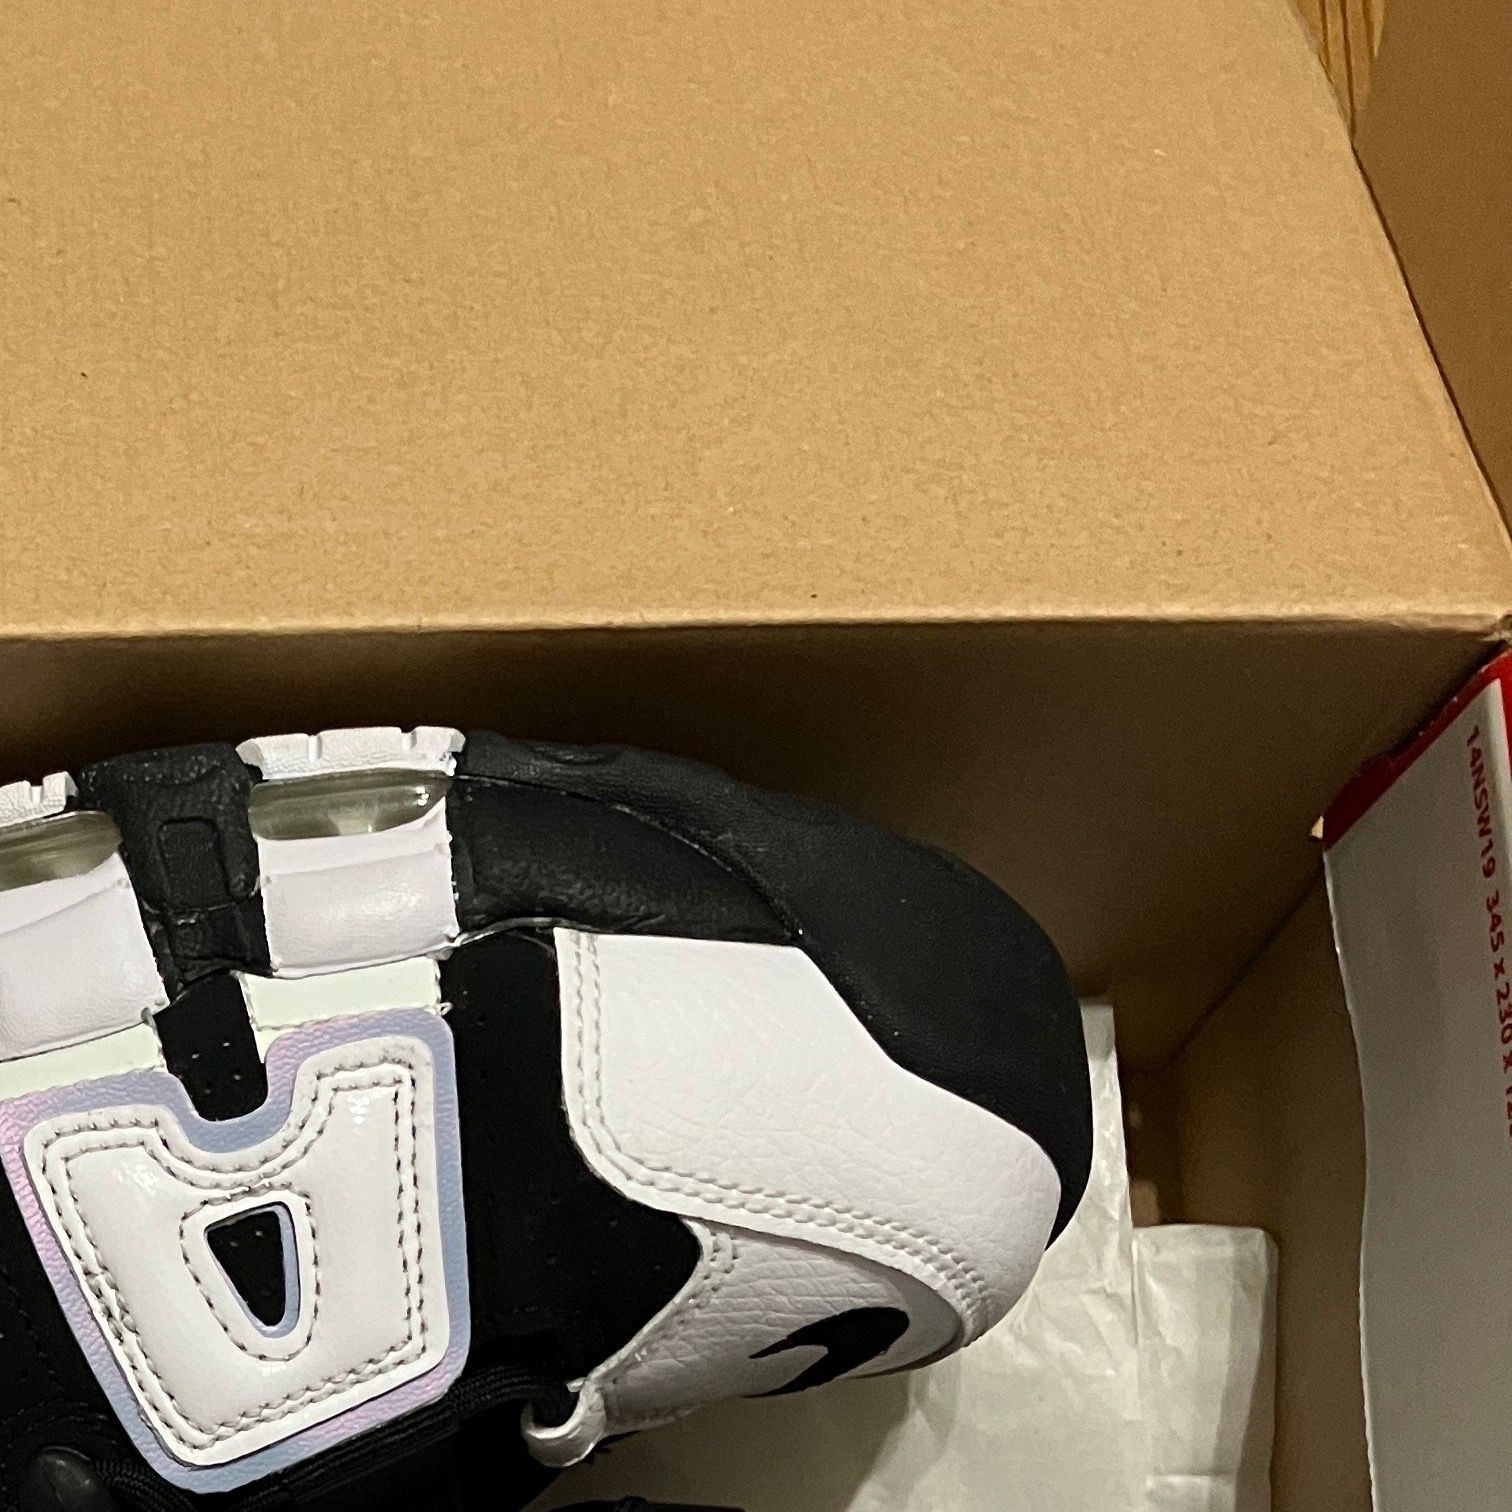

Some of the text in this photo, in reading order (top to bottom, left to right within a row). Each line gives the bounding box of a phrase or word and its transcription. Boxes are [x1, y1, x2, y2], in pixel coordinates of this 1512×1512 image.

[1466, 725, 1497, 879] 14NSW19
[1486, 890, 1506, 953] 345
[1493, 957, 1506, 981] x
